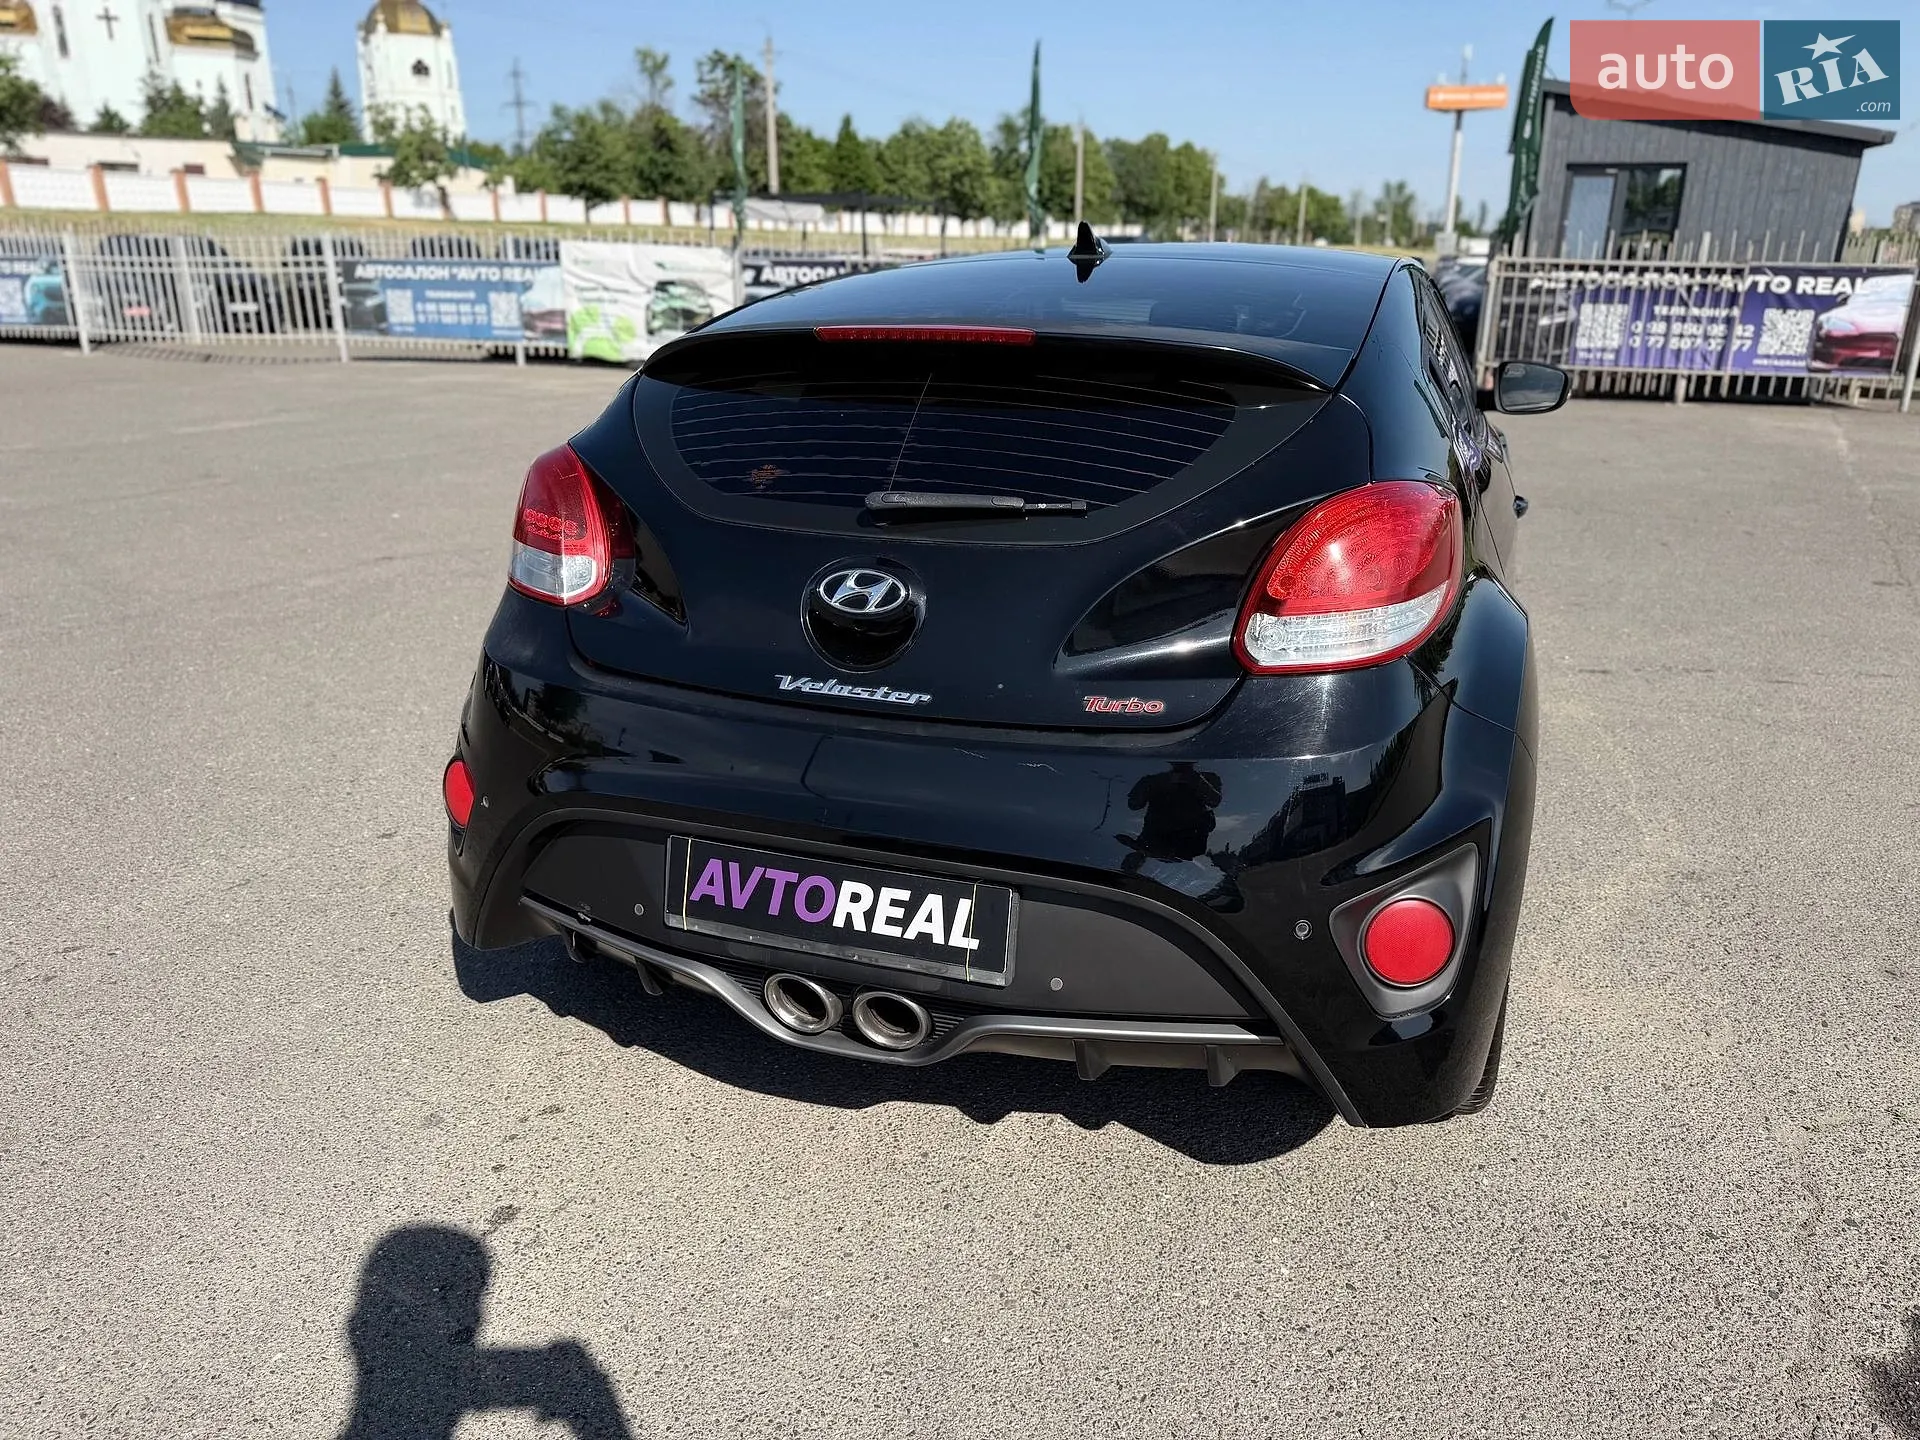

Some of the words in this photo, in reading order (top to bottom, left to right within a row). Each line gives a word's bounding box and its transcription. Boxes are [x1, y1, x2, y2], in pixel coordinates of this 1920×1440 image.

[355, 263, 449, 281] АВТОСАЛОН
[774, 674, 933, 706] Veloster
[1082, 694, 1166, 715] Turbo
[689, 858, 980, 951] AVTOREAL
